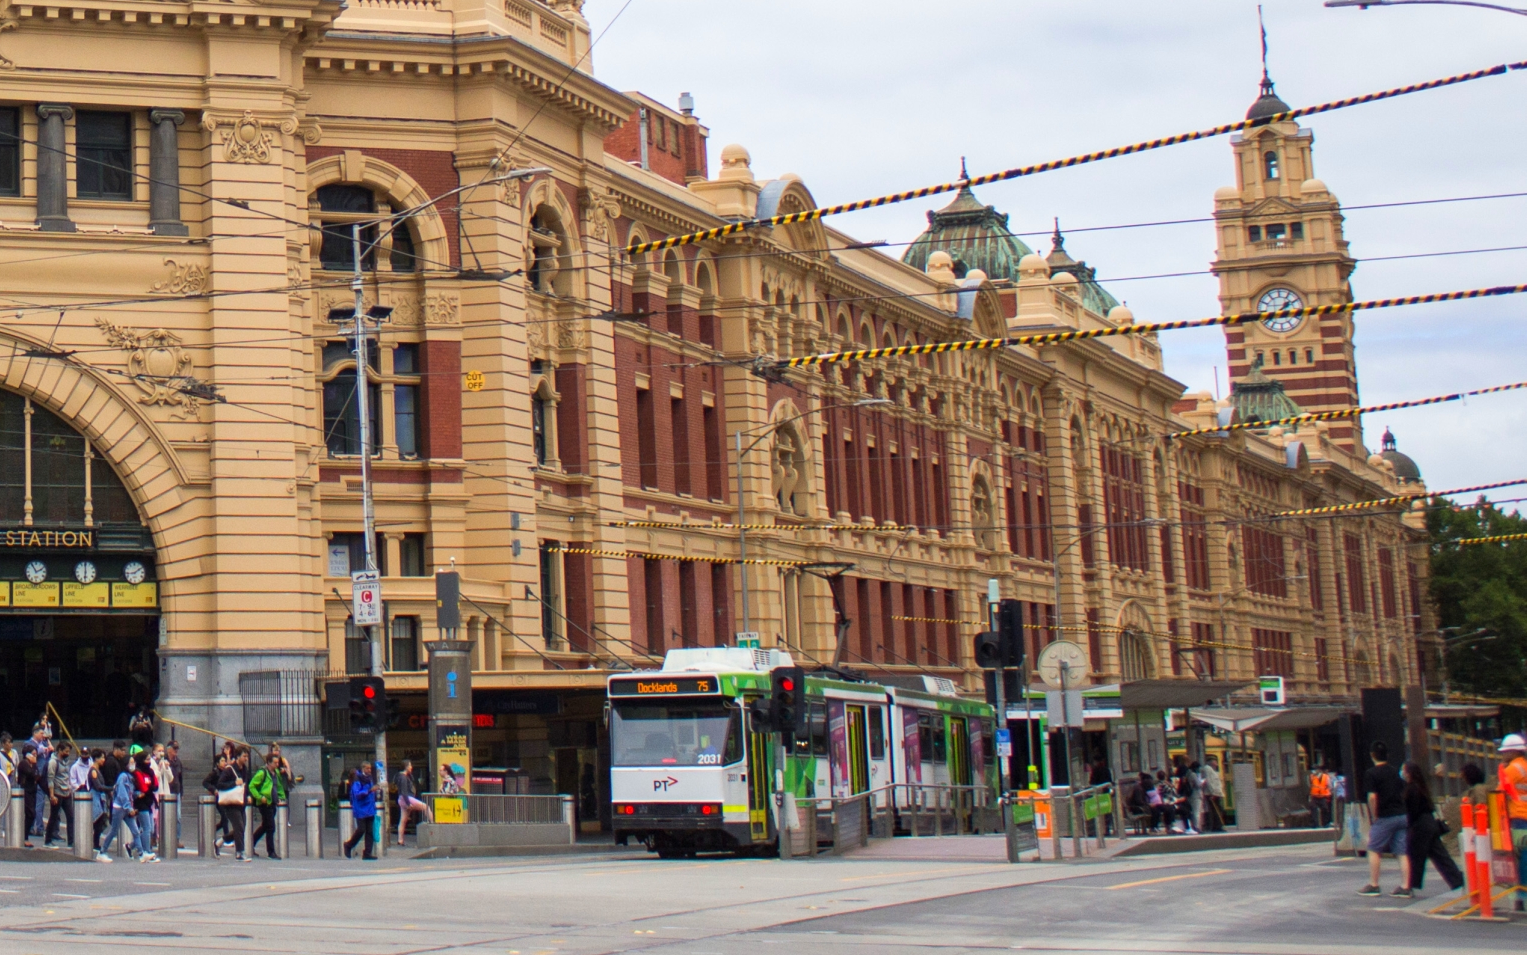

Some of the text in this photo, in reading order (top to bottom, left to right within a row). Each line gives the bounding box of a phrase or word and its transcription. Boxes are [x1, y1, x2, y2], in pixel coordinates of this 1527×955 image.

[466, 373, 482, 381] CUT
[5, 530, 92, 547] STATION
[638, 681, 708, 693] Docklands 75
[698, 754, 722, 764] 2031
